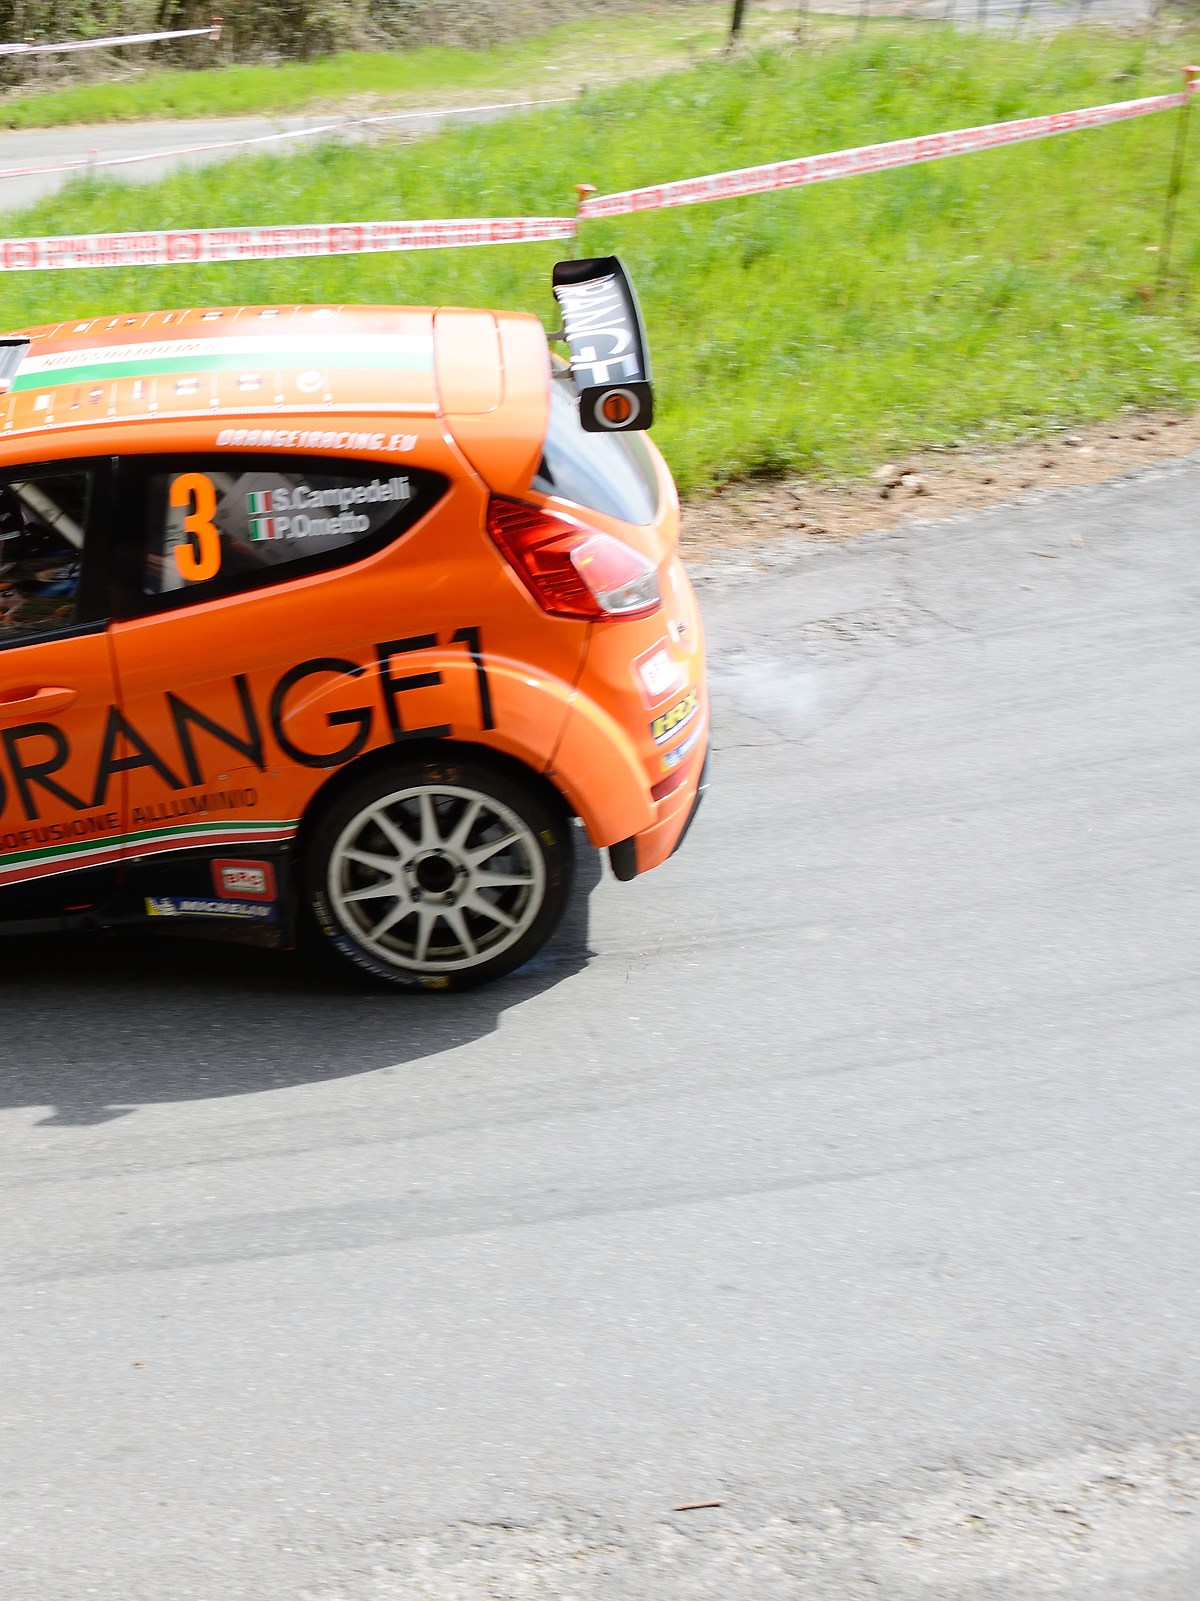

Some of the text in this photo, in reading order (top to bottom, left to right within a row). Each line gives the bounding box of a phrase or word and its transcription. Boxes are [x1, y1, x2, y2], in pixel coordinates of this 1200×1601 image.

[168, 472, 222, 582] 3
[131, 787, 259, 824] ALLUMINIO
[178, 900, 272, 917] MICHELIN
